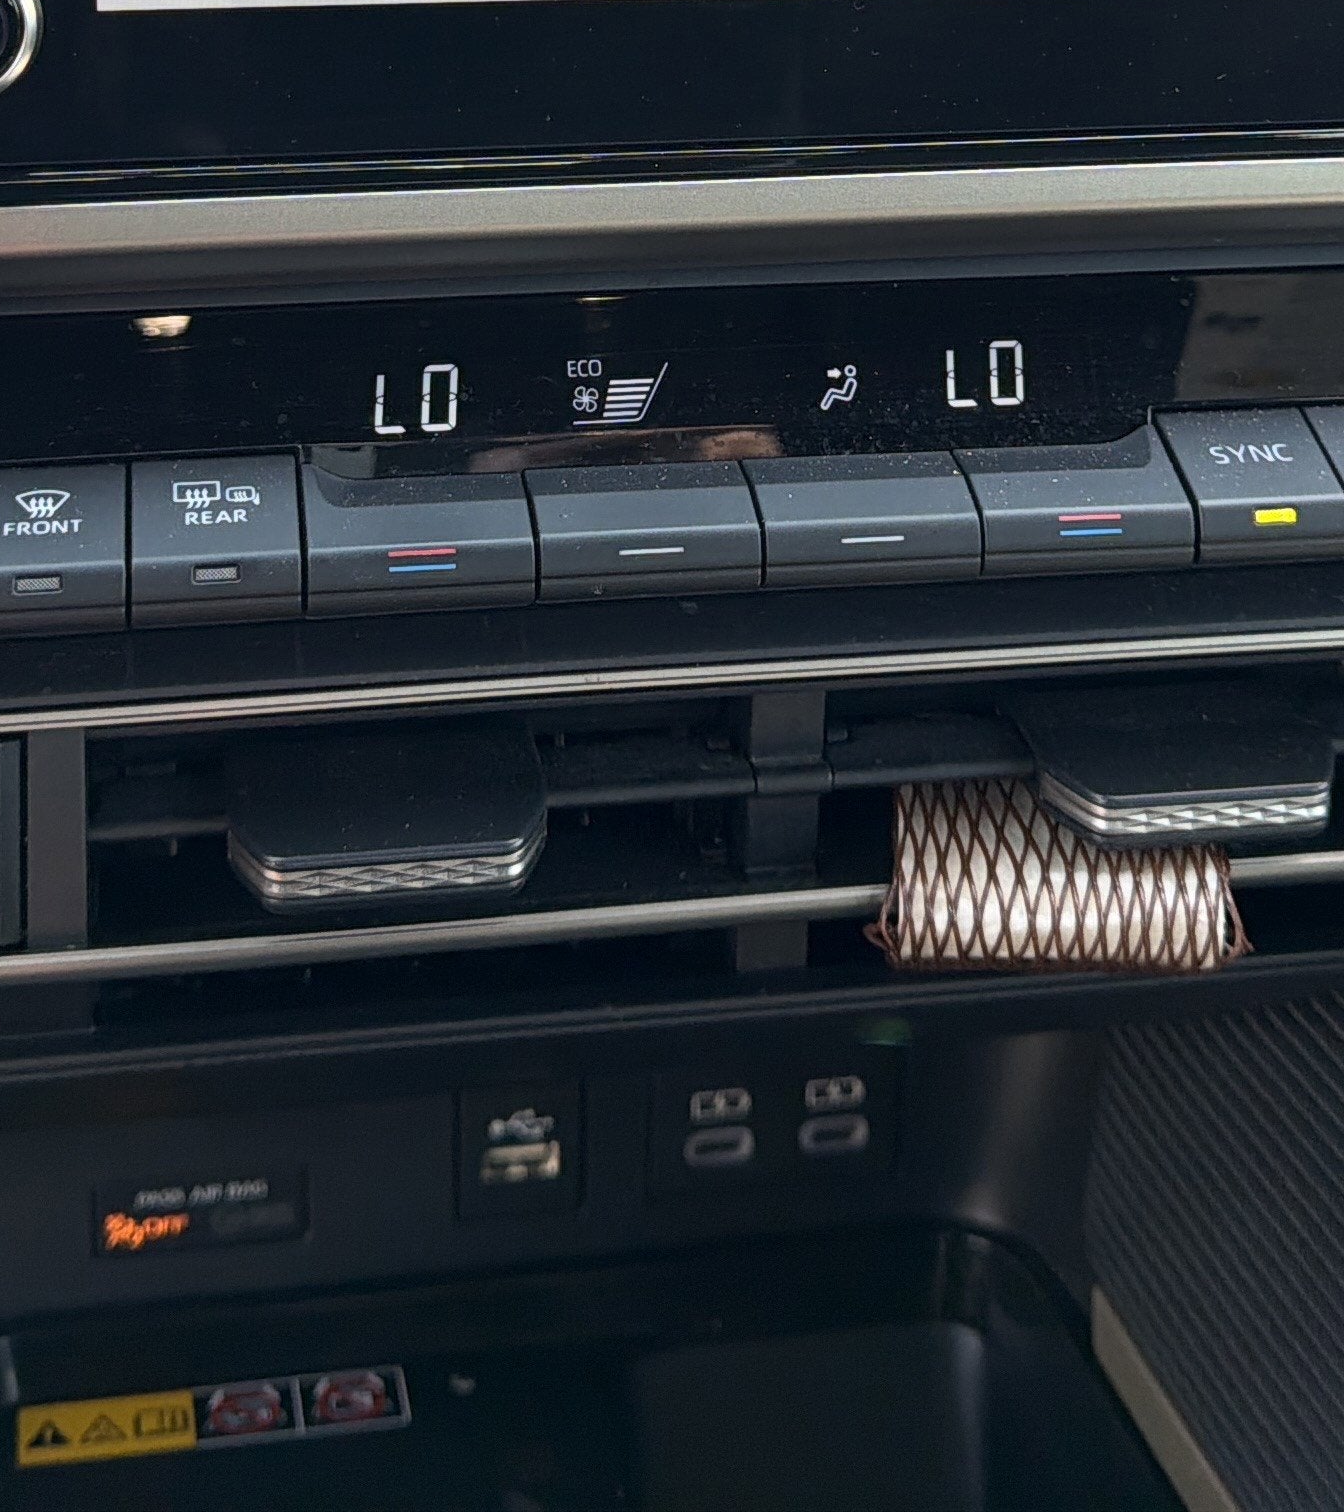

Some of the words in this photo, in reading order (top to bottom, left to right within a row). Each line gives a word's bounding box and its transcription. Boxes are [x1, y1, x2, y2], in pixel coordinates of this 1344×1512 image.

[567, 359, 603, 378] ECO
[1208, 438, 1294, 466] SYNC
[184, 507, 248, 526] REAR
[2, 518, 84, 537] FRONT
